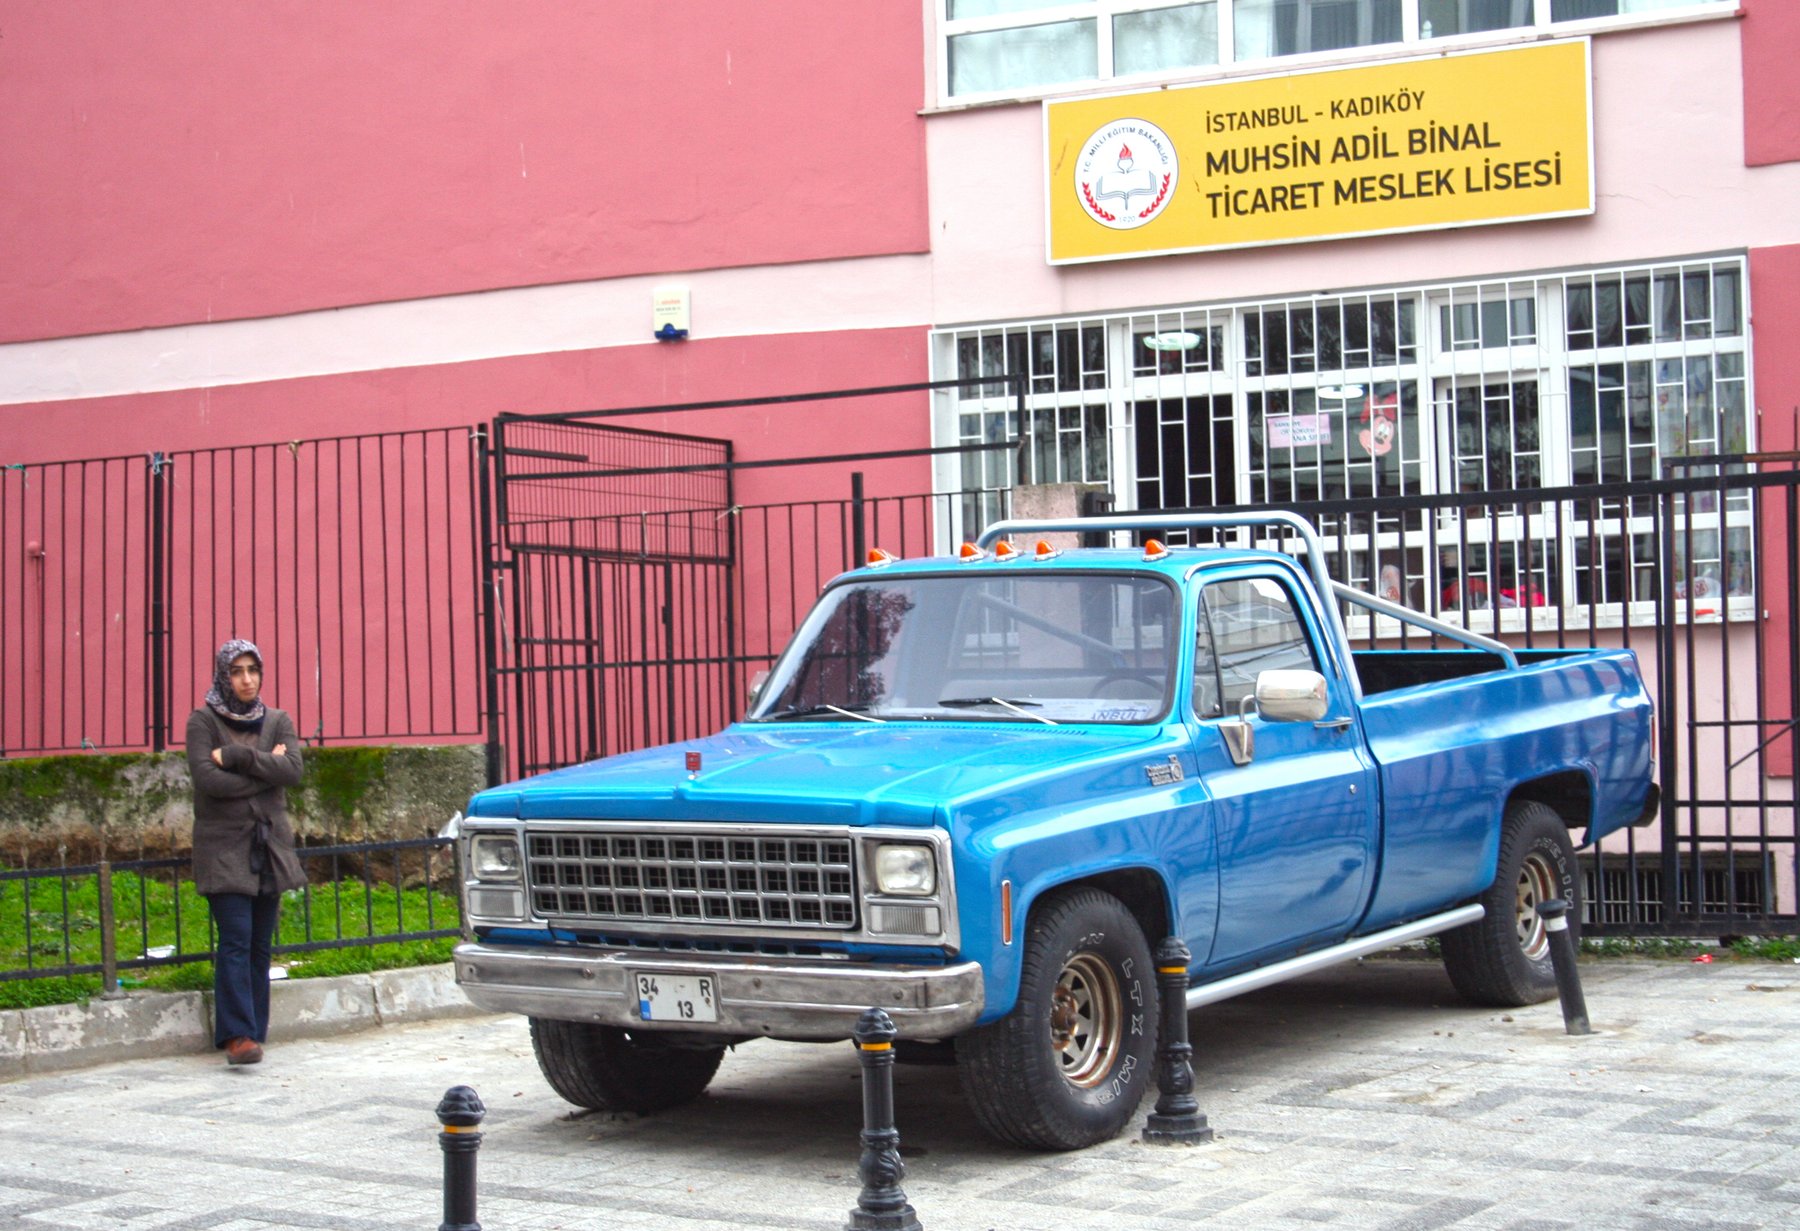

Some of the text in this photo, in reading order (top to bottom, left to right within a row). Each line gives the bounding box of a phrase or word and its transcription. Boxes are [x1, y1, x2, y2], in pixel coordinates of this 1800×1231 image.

[1206, 104, 1308, 134] İSTANBUL
[1330, 87, 1425, 120] KADIKÖY
[1206, 120, 1501, 177] MUHSİN ADİL BİNAL
[1206, 151, 1562, 219] TİCARET MESLEK LİSESİ
[640, 977, 711, 997] 34 R
[677, 1000, 694, 1018] 13
[1121, 957, 1144, 1039] LTX
